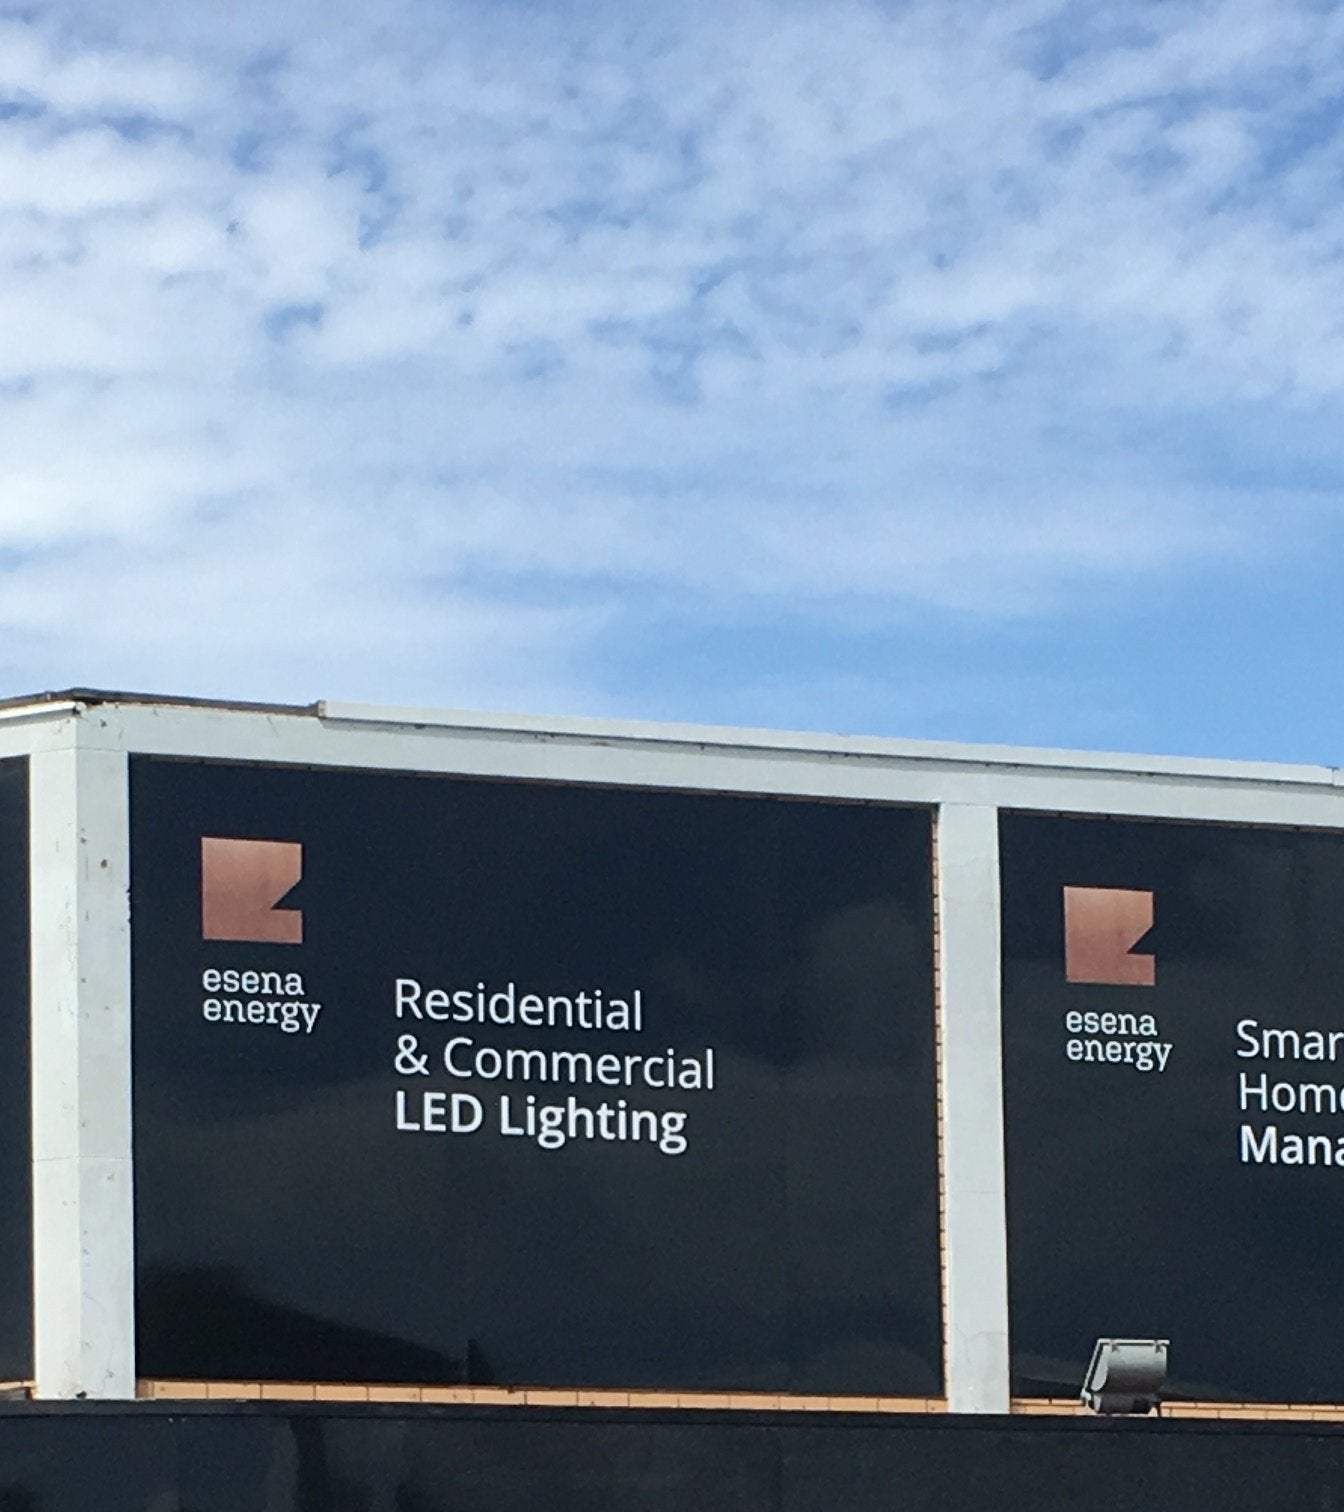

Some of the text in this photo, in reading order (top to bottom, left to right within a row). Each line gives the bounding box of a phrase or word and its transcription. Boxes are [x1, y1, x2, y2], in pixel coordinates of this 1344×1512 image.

[201, 967, 305, 996] esena
[202, 994, 321, 1034] energy
[395, 978, 641, 1031] Residential
[1065, 1009, 1159, 1037] esena
[394, 1034, 715, 1091] & Commercial
[1065, 1036, 1173, 1072] energy
[396, 1090, 689, 1156] LED Lighting
